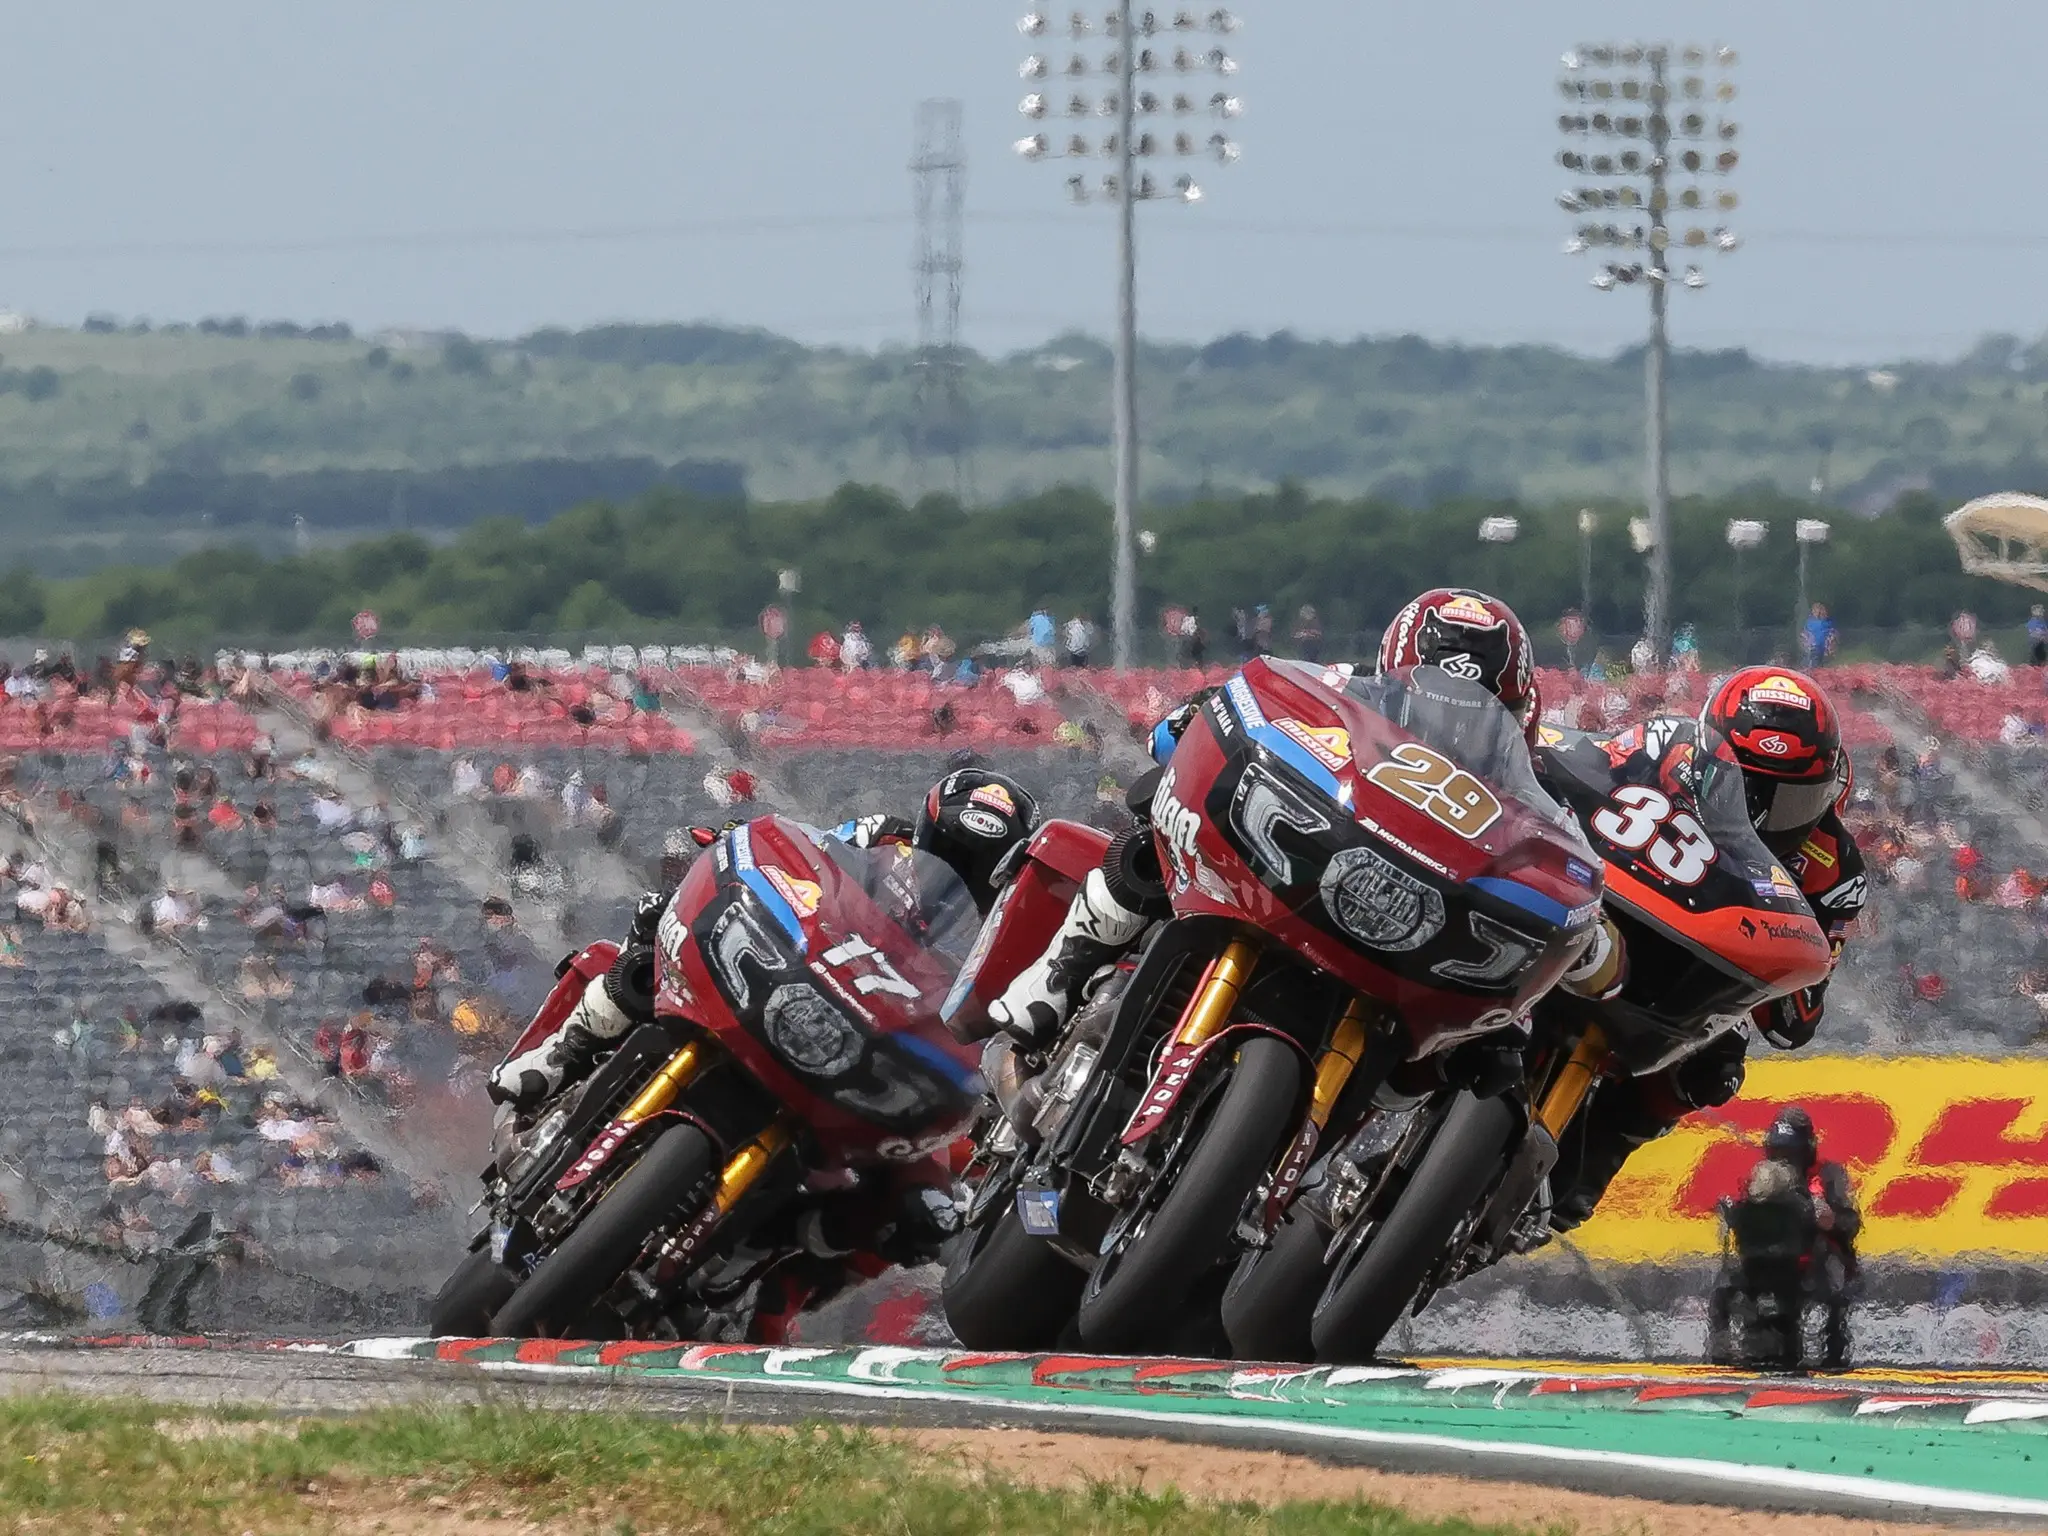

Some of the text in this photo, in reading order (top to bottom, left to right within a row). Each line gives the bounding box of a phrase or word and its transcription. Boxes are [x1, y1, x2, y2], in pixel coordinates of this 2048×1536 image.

[1426, 691, 1450, 704] TYLER
[964, 815, 1002, 832] SUOMY
[1366, 743, 1503, 840] 29
[1377, 828, 1449, 875] MOTOAMERICA
[1591, 784, 1717, 886] 33
[822, 932, 922, 998] 17
[1672, 1094, 2048, 1219] DH
